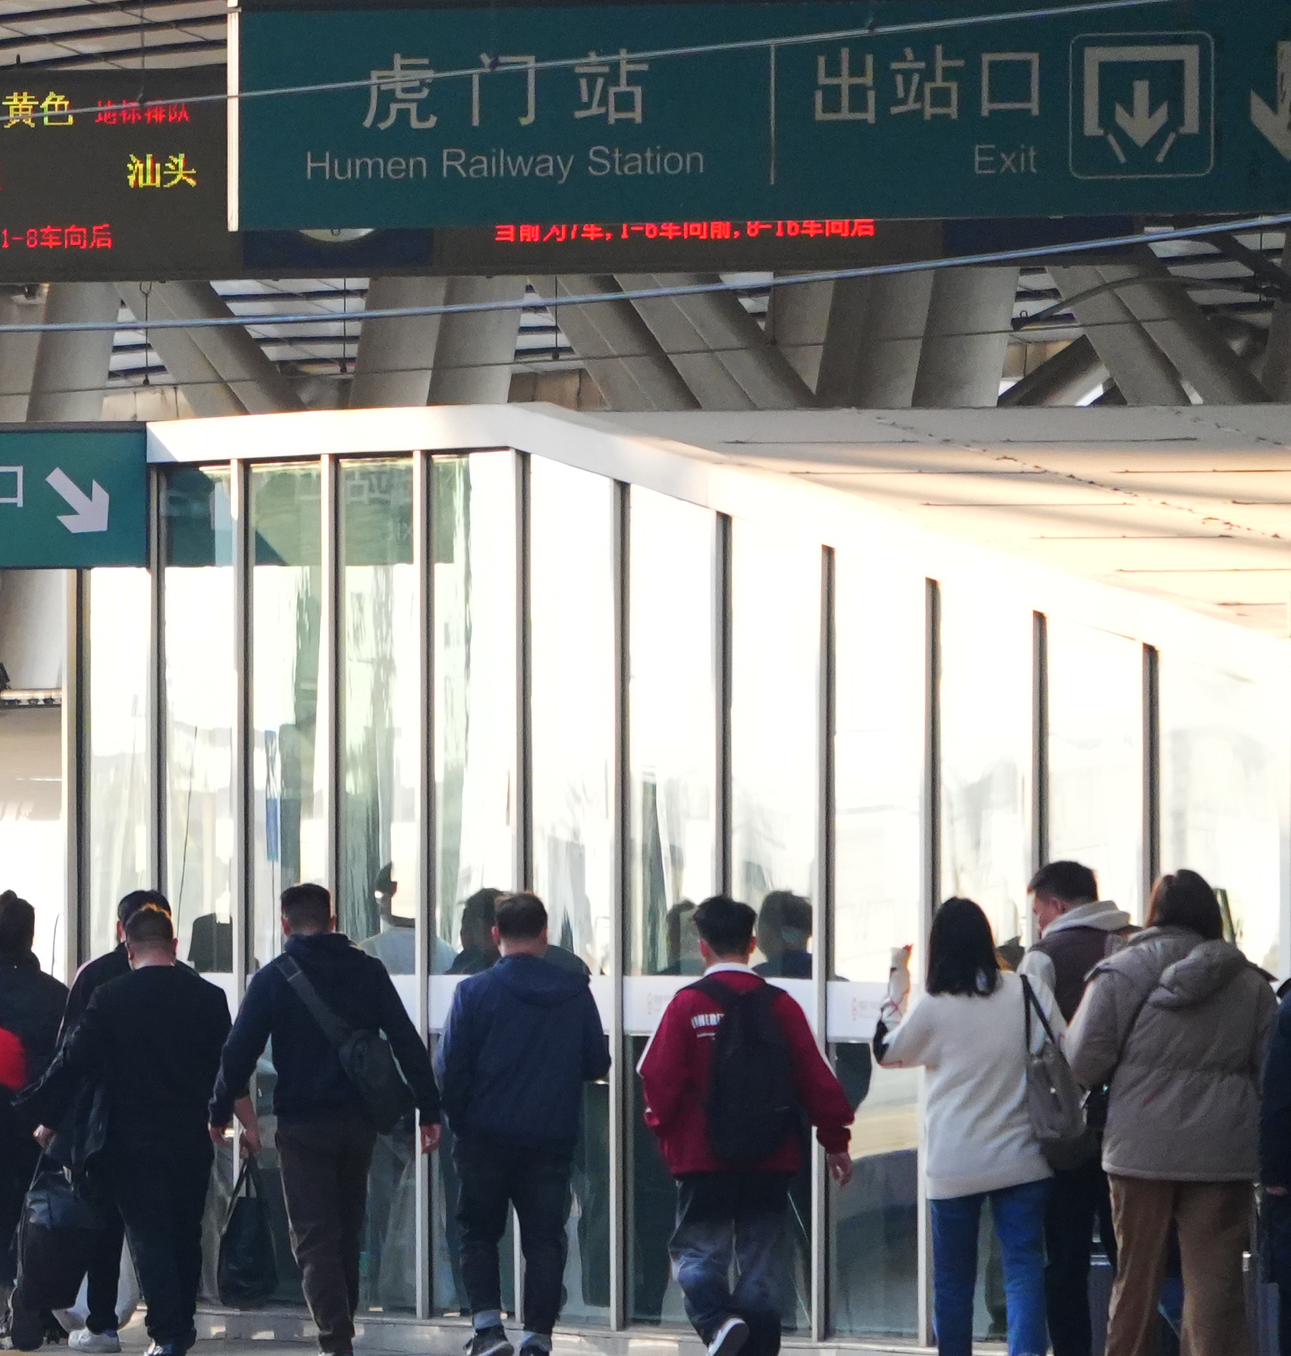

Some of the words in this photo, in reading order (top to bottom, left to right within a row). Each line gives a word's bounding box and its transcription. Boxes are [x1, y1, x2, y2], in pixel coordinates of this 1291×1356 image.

[362, 48, 650, 131] 虎门站
[814, 44, 1040, 124] 出站口
[2, 91, 74, 129] 黄色
[126, 153, 198, 189] 汕头
[306, 151, 428, 181] Humen
[441, 148, 575, 185] Railway
[587, 145, 705, 177] Station
[973, 143, 1038, 174] Exit
